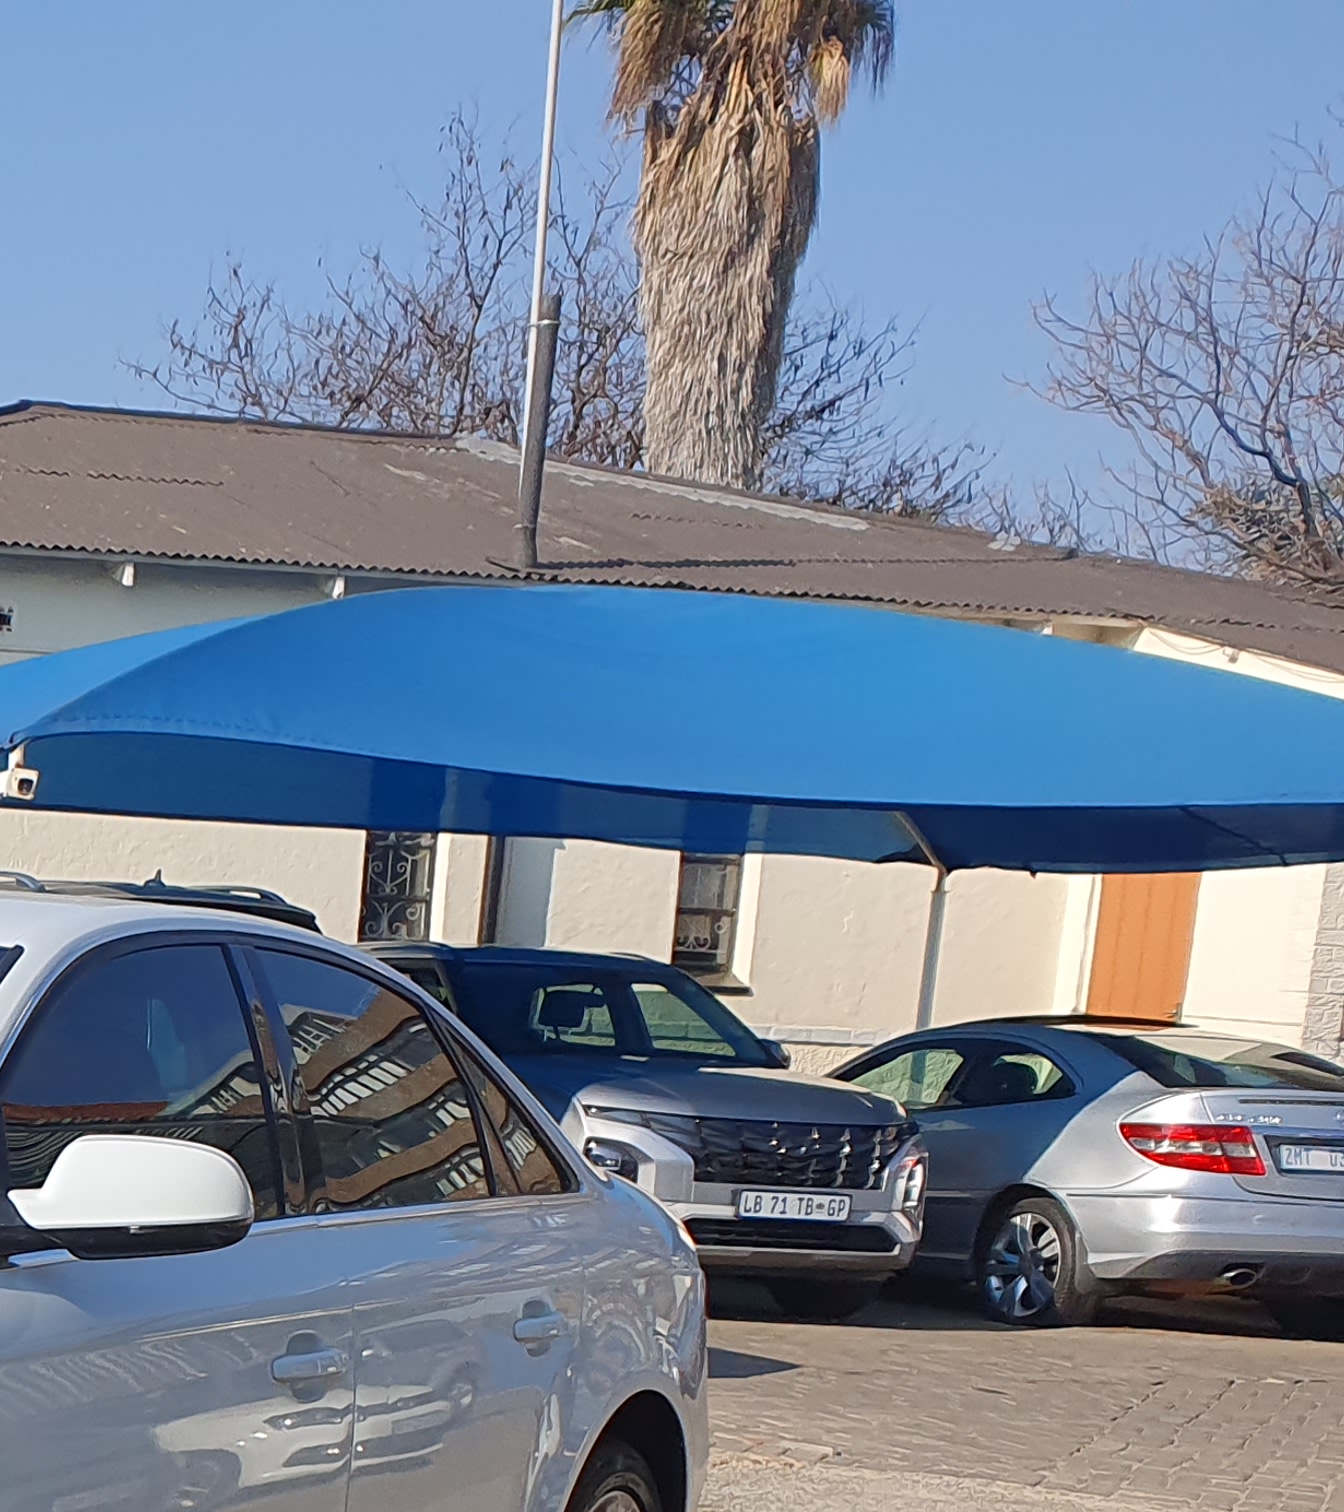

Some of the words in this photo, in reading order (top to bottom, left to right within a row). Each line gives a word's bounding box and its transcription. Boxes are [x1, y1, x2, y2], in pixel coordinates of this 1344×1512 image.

[743, 1194, 763, 1214] LB
[771, 1196, 788, 1214] 71
[797, 1197, 814, 1216] TB
[827, 1199, 846, 1217] GP
